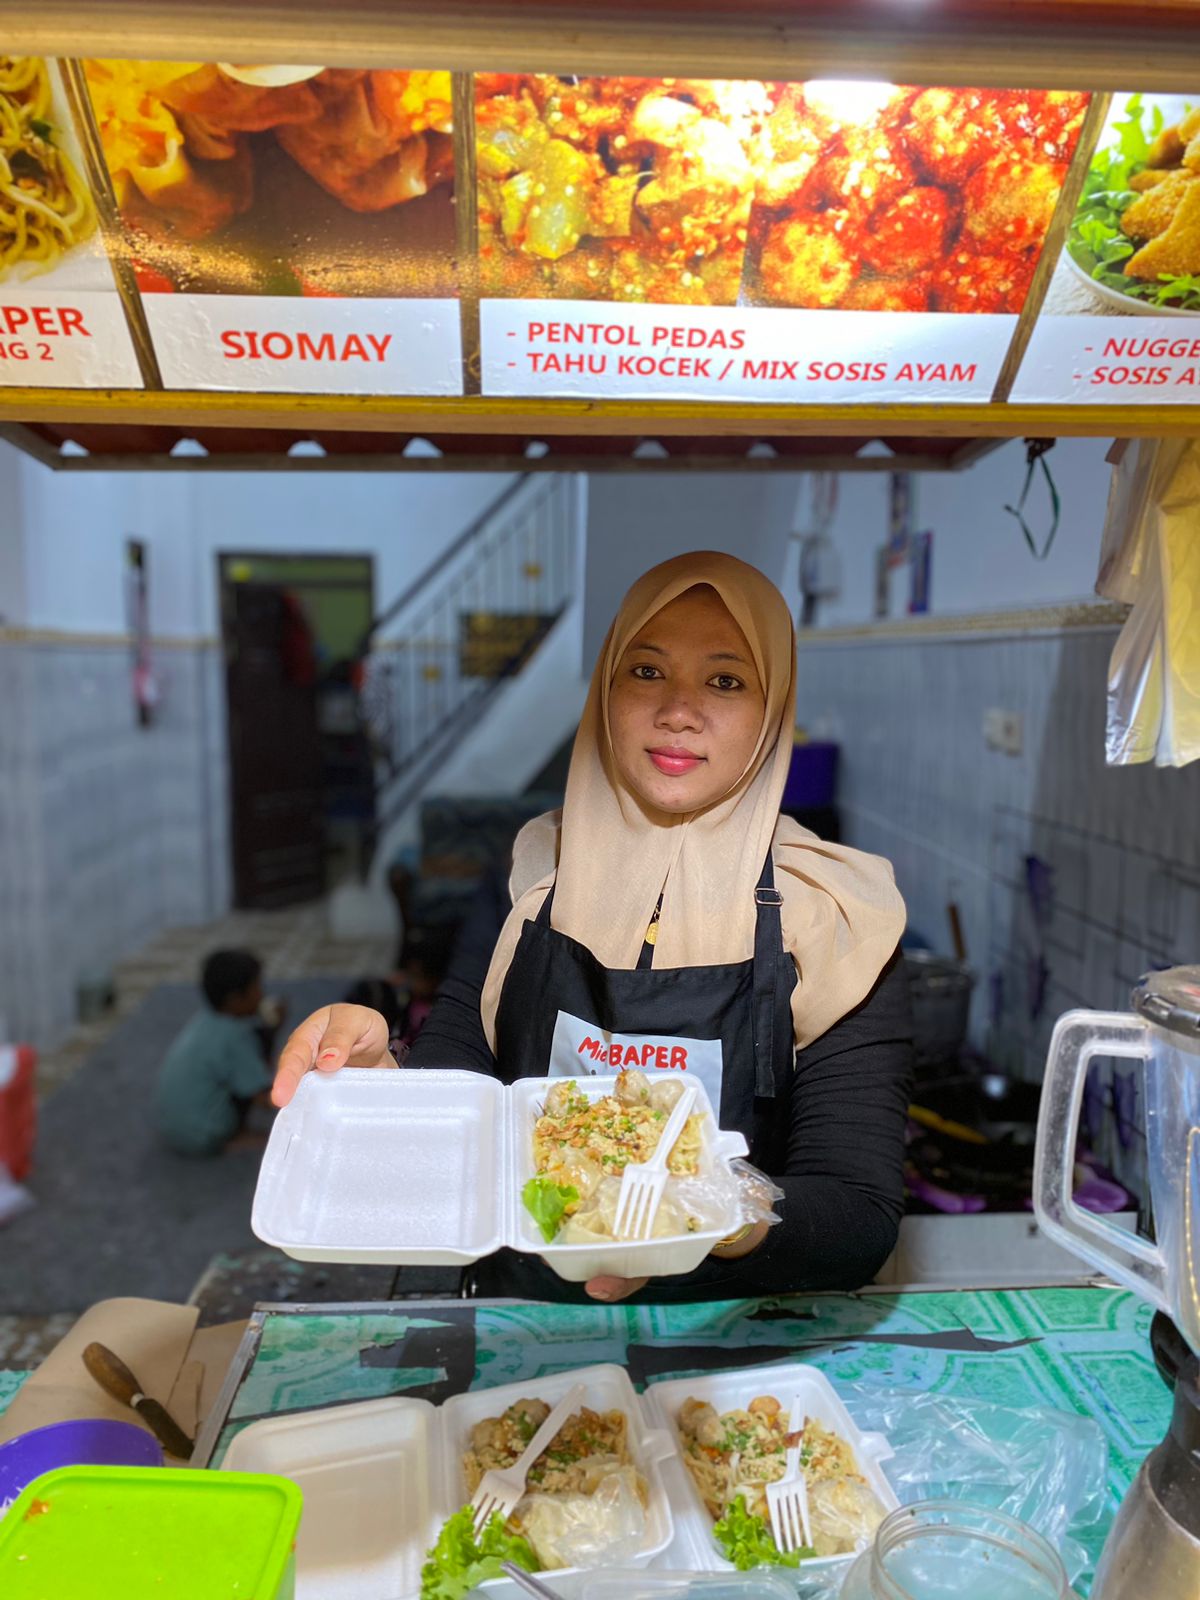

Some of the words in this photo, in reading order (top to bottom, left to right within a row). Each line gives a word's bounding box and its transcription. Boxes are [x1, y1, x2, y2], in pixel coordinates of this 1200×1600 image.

[0, 305, 93, 337] PER
[527, 321, 642, 347] PENTOL
[651, 326, 746, 350] PEDAS
[36, 341, 55, 361] 2
[219, 329, 393, 363] SIOMAY
[526, 352, 607, 375] TAHU
[617, 355, 712, 378] KOCEK
[742, 359, 799, 381] MIX
[806, 361, 887, 383] SOSIS
[895, 363, 977, 383] AYAM
[1090, 365, 1173, 385] SOSIS
[1175, 366, 1200, 385] A
